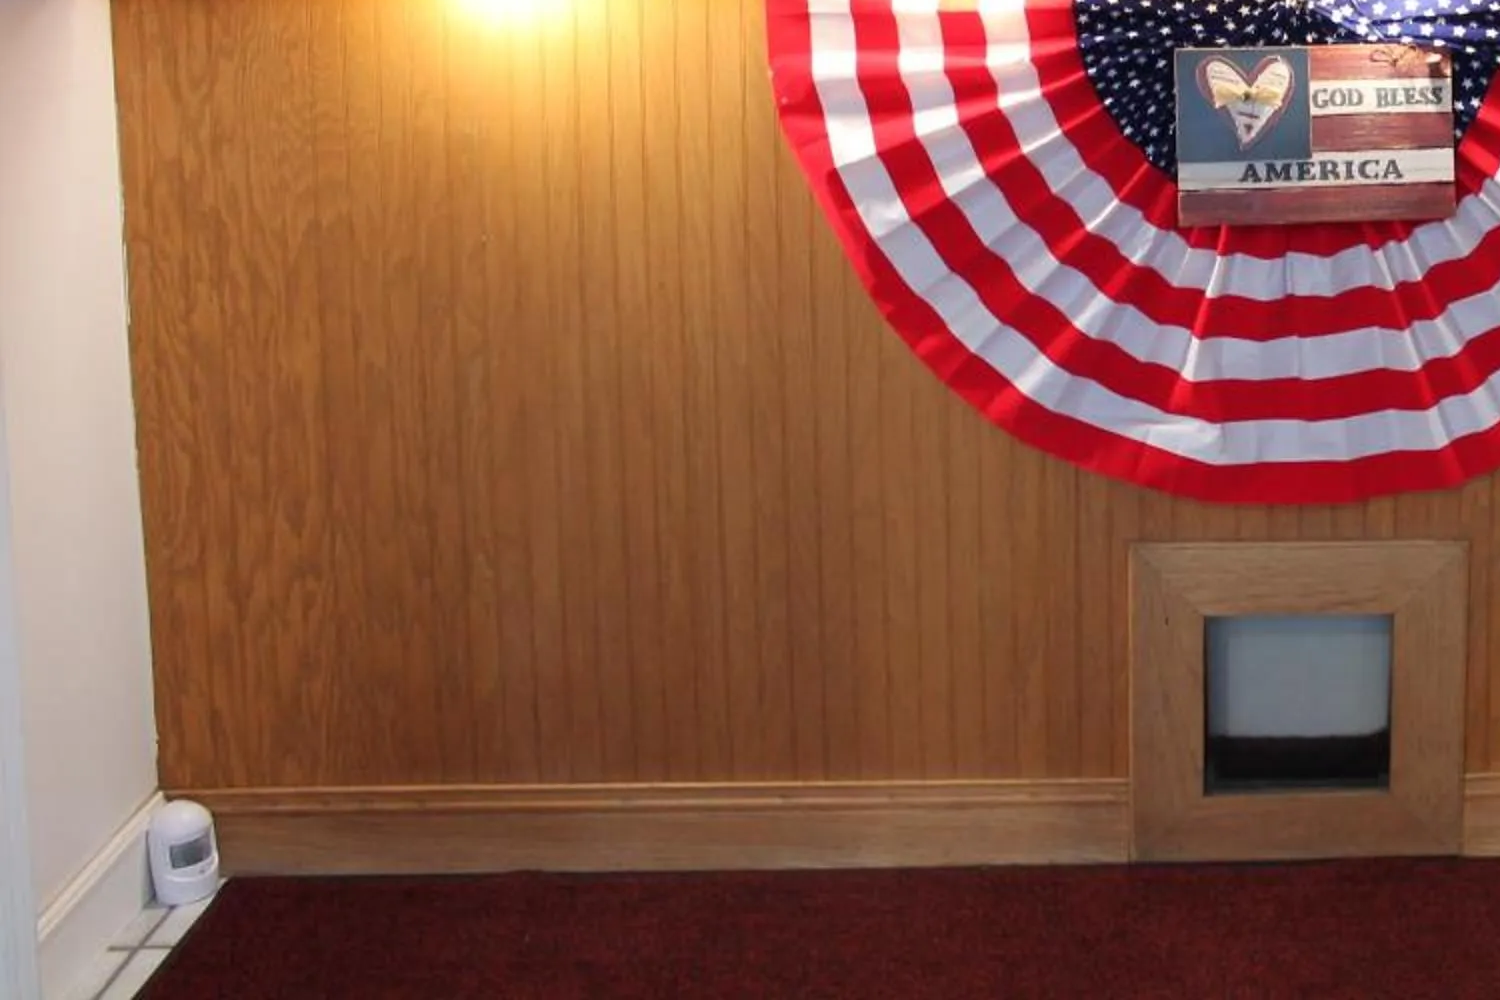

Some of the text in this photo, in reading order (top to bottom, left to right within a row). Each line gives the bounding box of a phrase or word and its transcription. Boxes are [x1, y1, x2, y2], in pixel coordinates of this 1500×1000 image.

[1312, 86, 1443, 108] GOD BLESS
[1240, 159, 1404, 183] AMERICA
